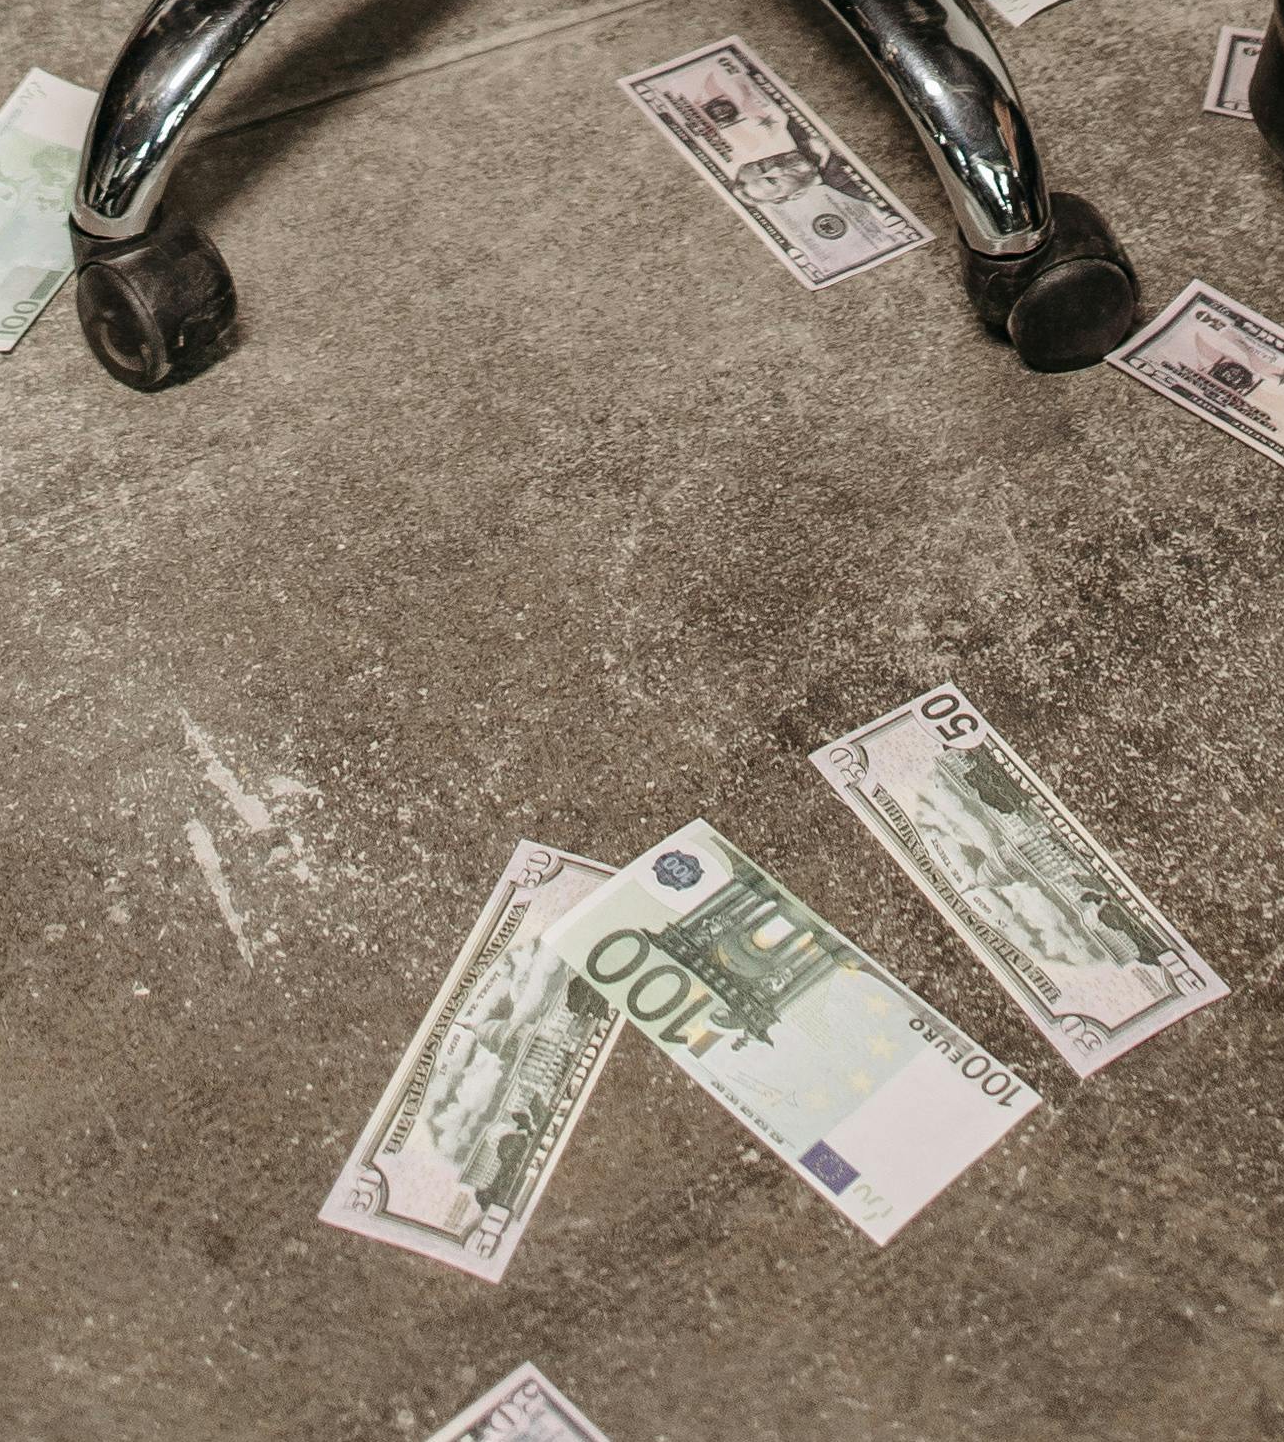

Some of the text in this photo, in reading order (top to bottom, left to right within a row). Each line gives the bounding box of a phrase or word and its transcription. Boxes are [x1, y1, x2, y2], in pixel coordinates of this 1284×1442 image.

[1192, 309, 1227, 331] 50
[917, 690, 982, 744] 50
[824, 744, 869, 785] 50
[860, 784, 932, 856] AMERICA
[987, 744, 1084, 846] DOLLARS
[973, 917, 1034, 977] UNITED
[585, 929, 710, 1051] 100
[1025, 967, 1063, 1004] THE
[906, 1015, 1027, 1110] 100 EURO
